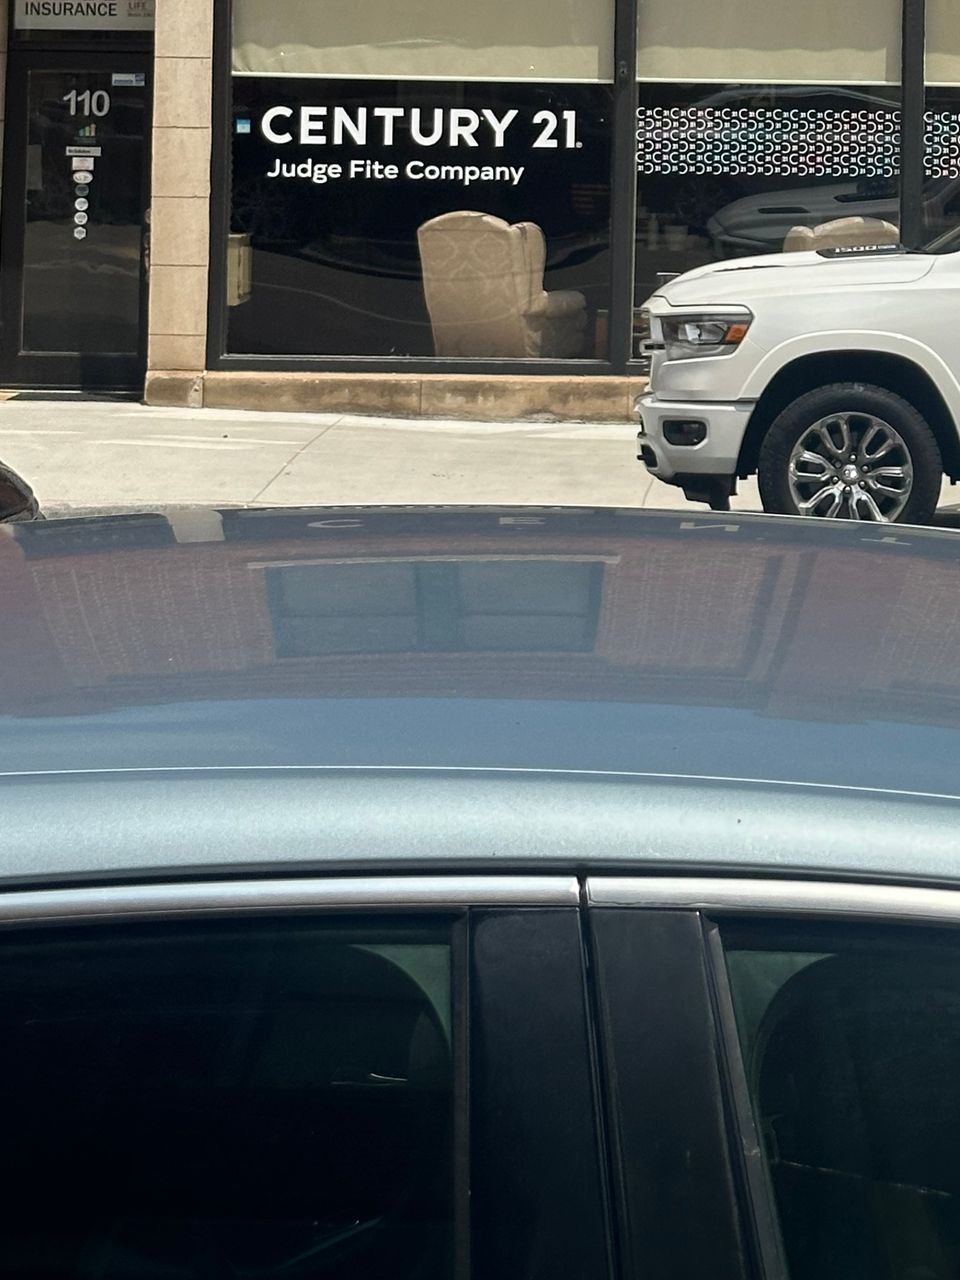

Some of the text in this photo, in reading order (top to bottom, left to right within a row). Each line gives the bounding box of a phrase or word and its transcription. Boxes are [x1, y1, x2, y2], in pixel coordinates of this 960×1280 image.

[25, 2, 118, 17] INSURANCE
[62, 89, 111, 118] 110
[260, 104, 519, 149] CENTURY
[266, 156, 526, 187] Judge Fite Company
